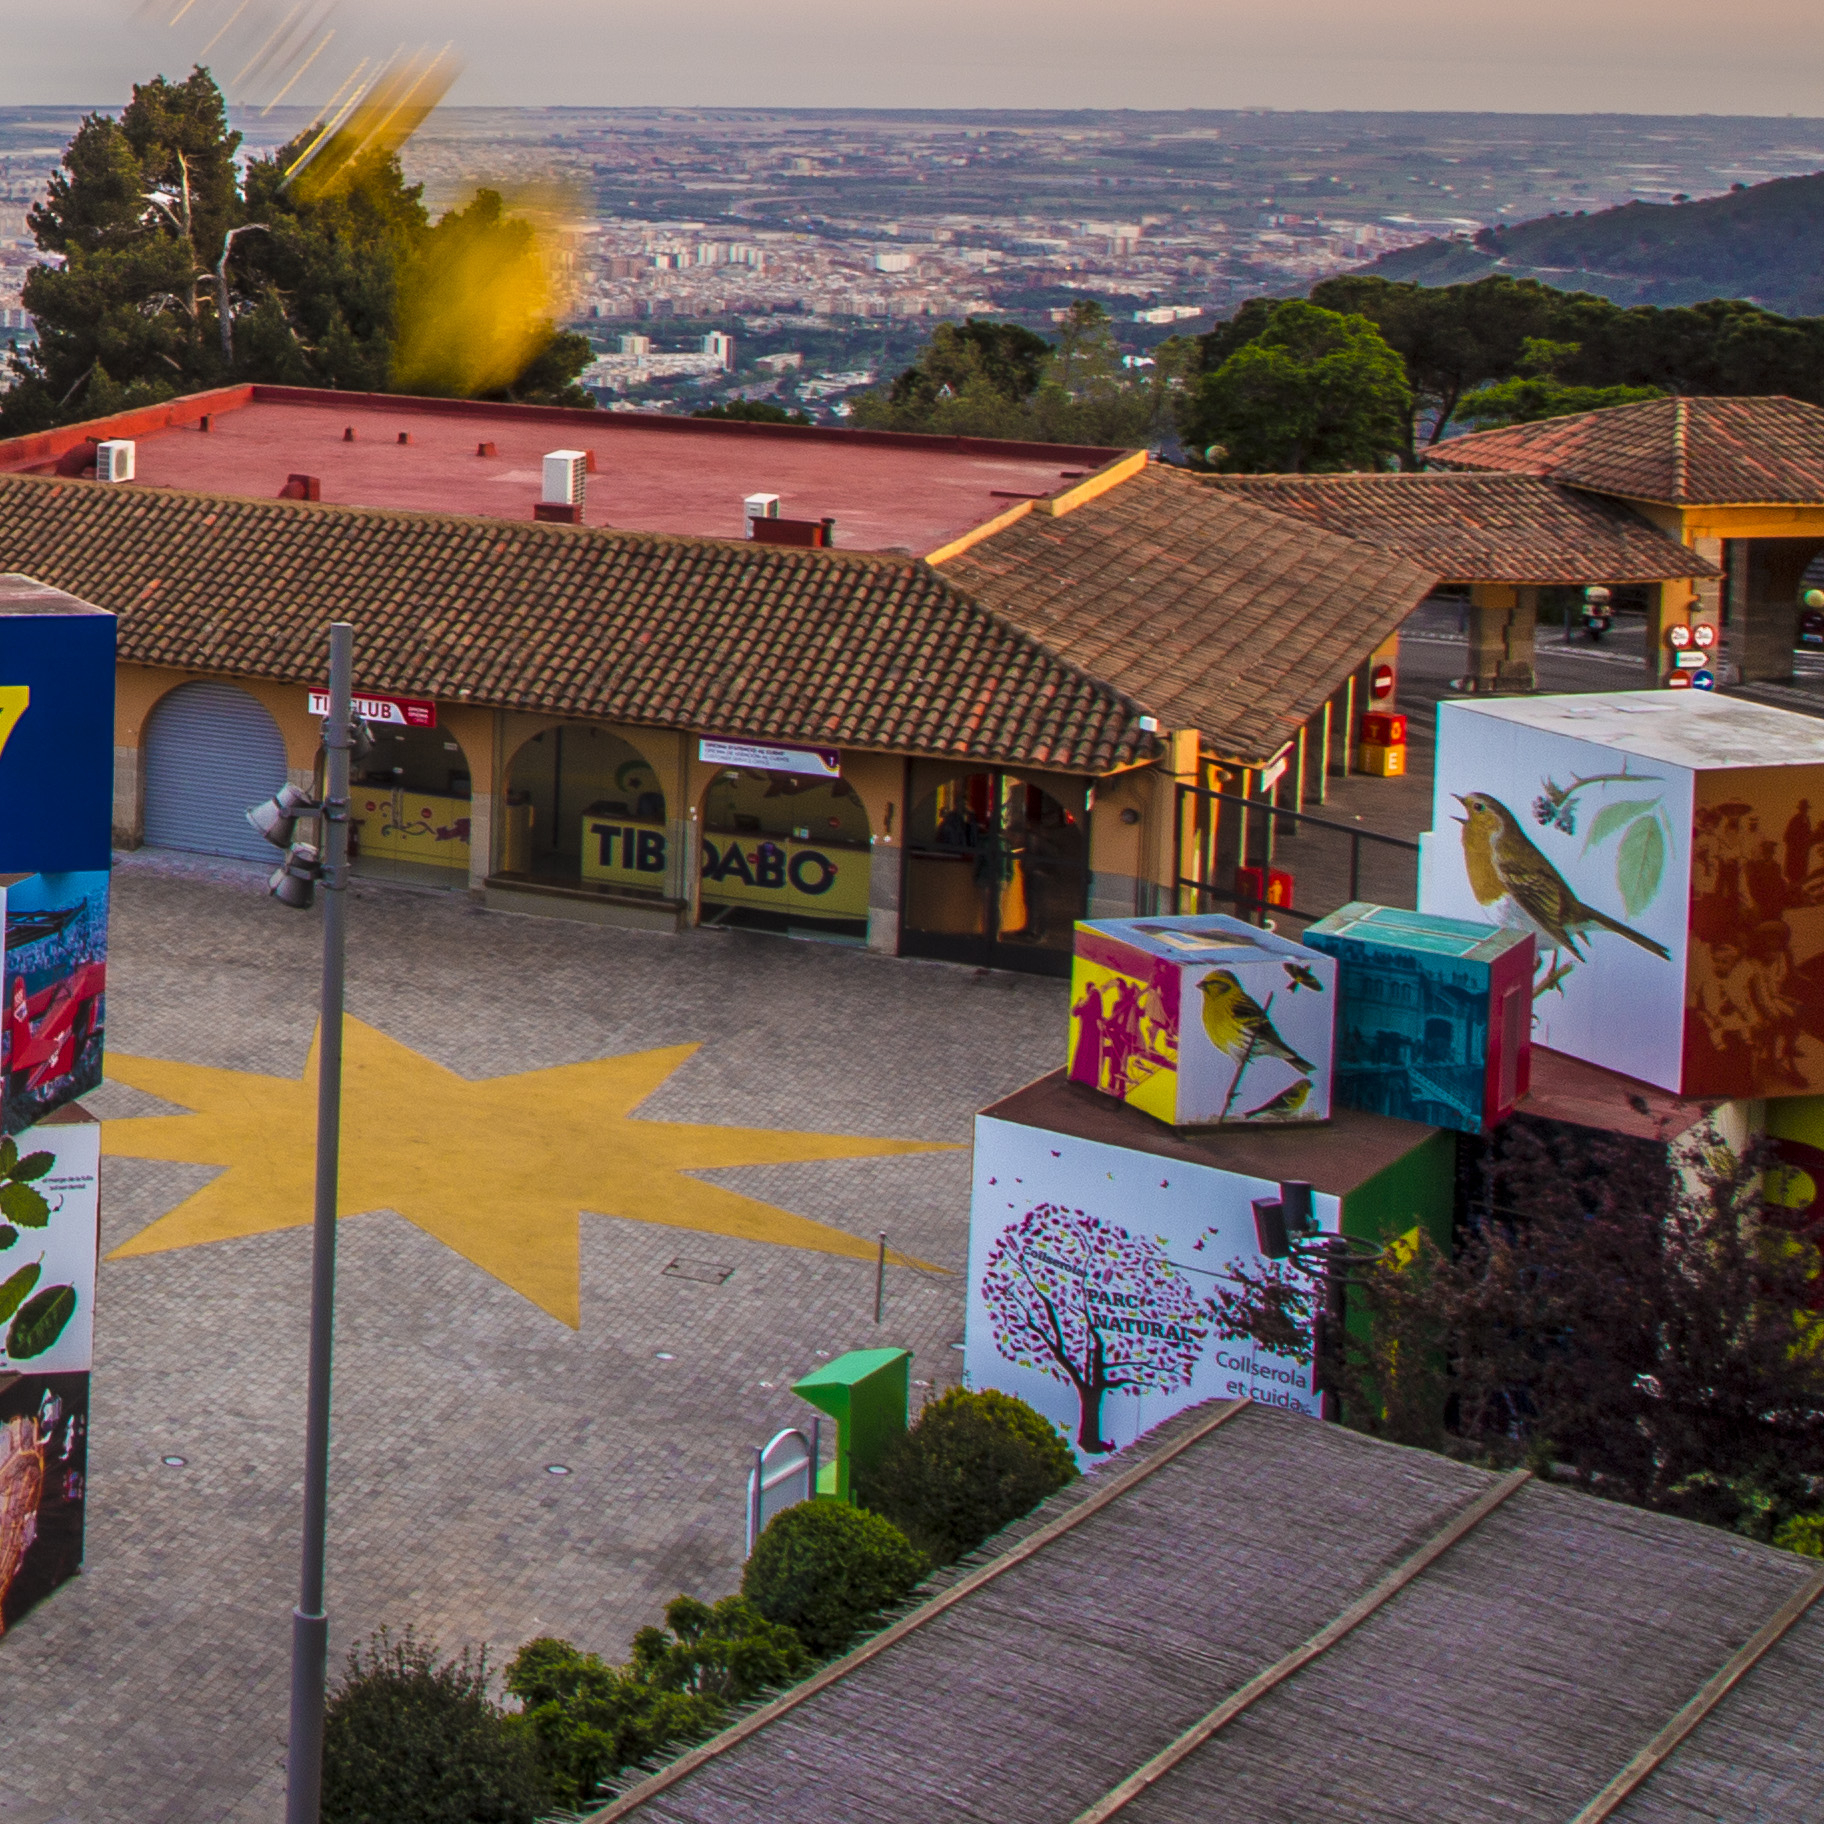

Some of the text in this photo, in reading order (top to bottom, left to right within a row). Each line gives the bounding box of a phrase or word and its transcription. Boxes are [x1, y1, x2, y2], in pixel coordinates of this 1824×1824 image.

[590, 823, 836, 896] TIBDABO
[1086, 1287, 1139, 1310] PARC
[1092, 1313, 1194, 1344] NATURAL
[1214, 1350, 1306, 1389] Collserola
[1226, 1380, 1246, 1398] et
